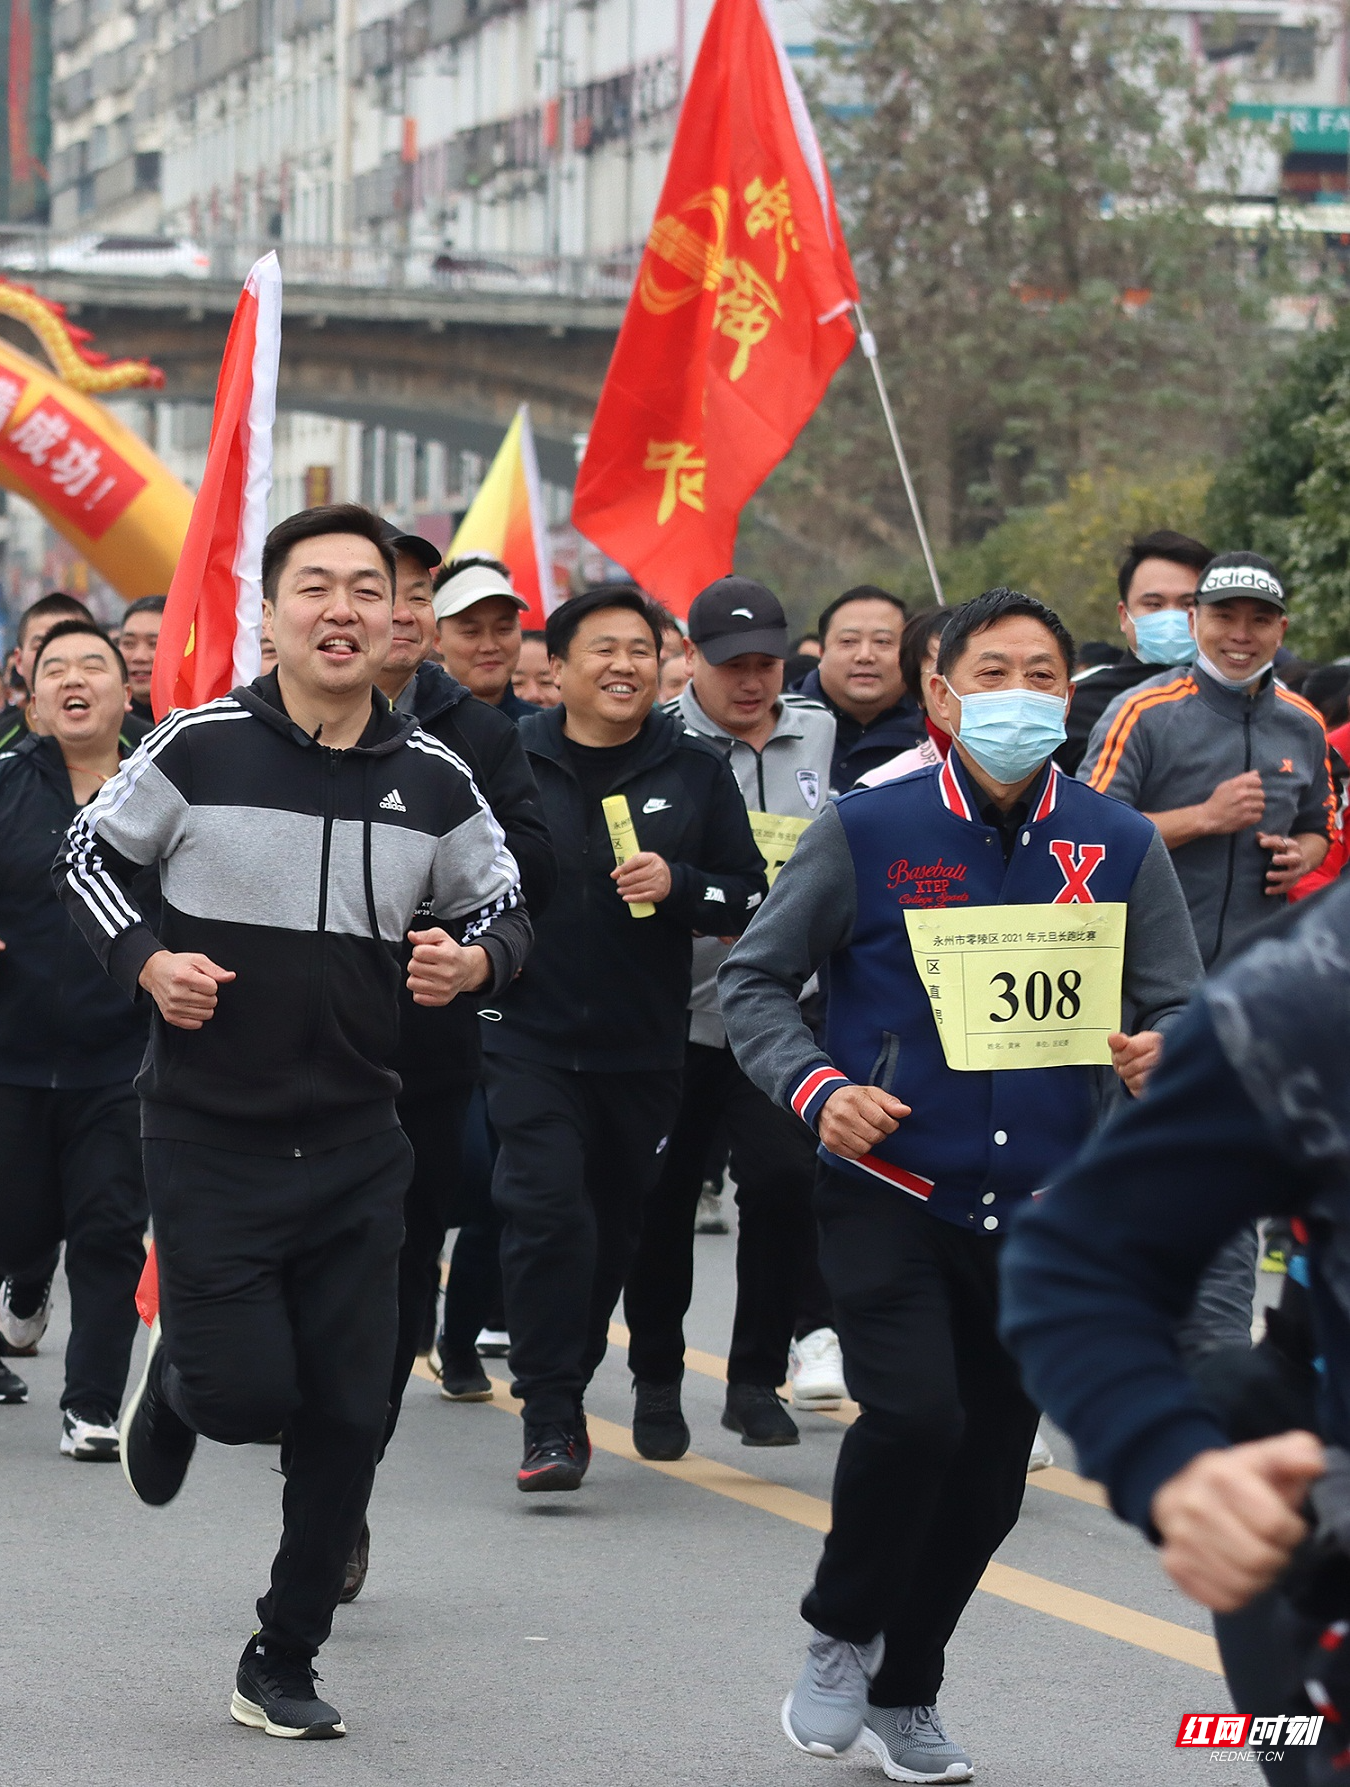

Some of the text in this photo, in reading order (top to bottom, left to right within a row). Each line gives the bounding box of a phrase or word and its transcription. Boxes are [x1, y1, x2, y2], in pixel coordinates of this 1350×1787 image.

[1206, 572, 1280, 596] adidas
[378, 801, 407, 813] adidas
[887, 857, 968, 889] Baseball
[1049, 839, 1105, 905] X
[914, 880, 950, 894] XTEP
[898, 891, 969, 906] College Sports
[933, 930, 1097, 947] 永州市零陵区 2021 年元旦长跑比赛
[989, 969, 1082, 1023] 308
